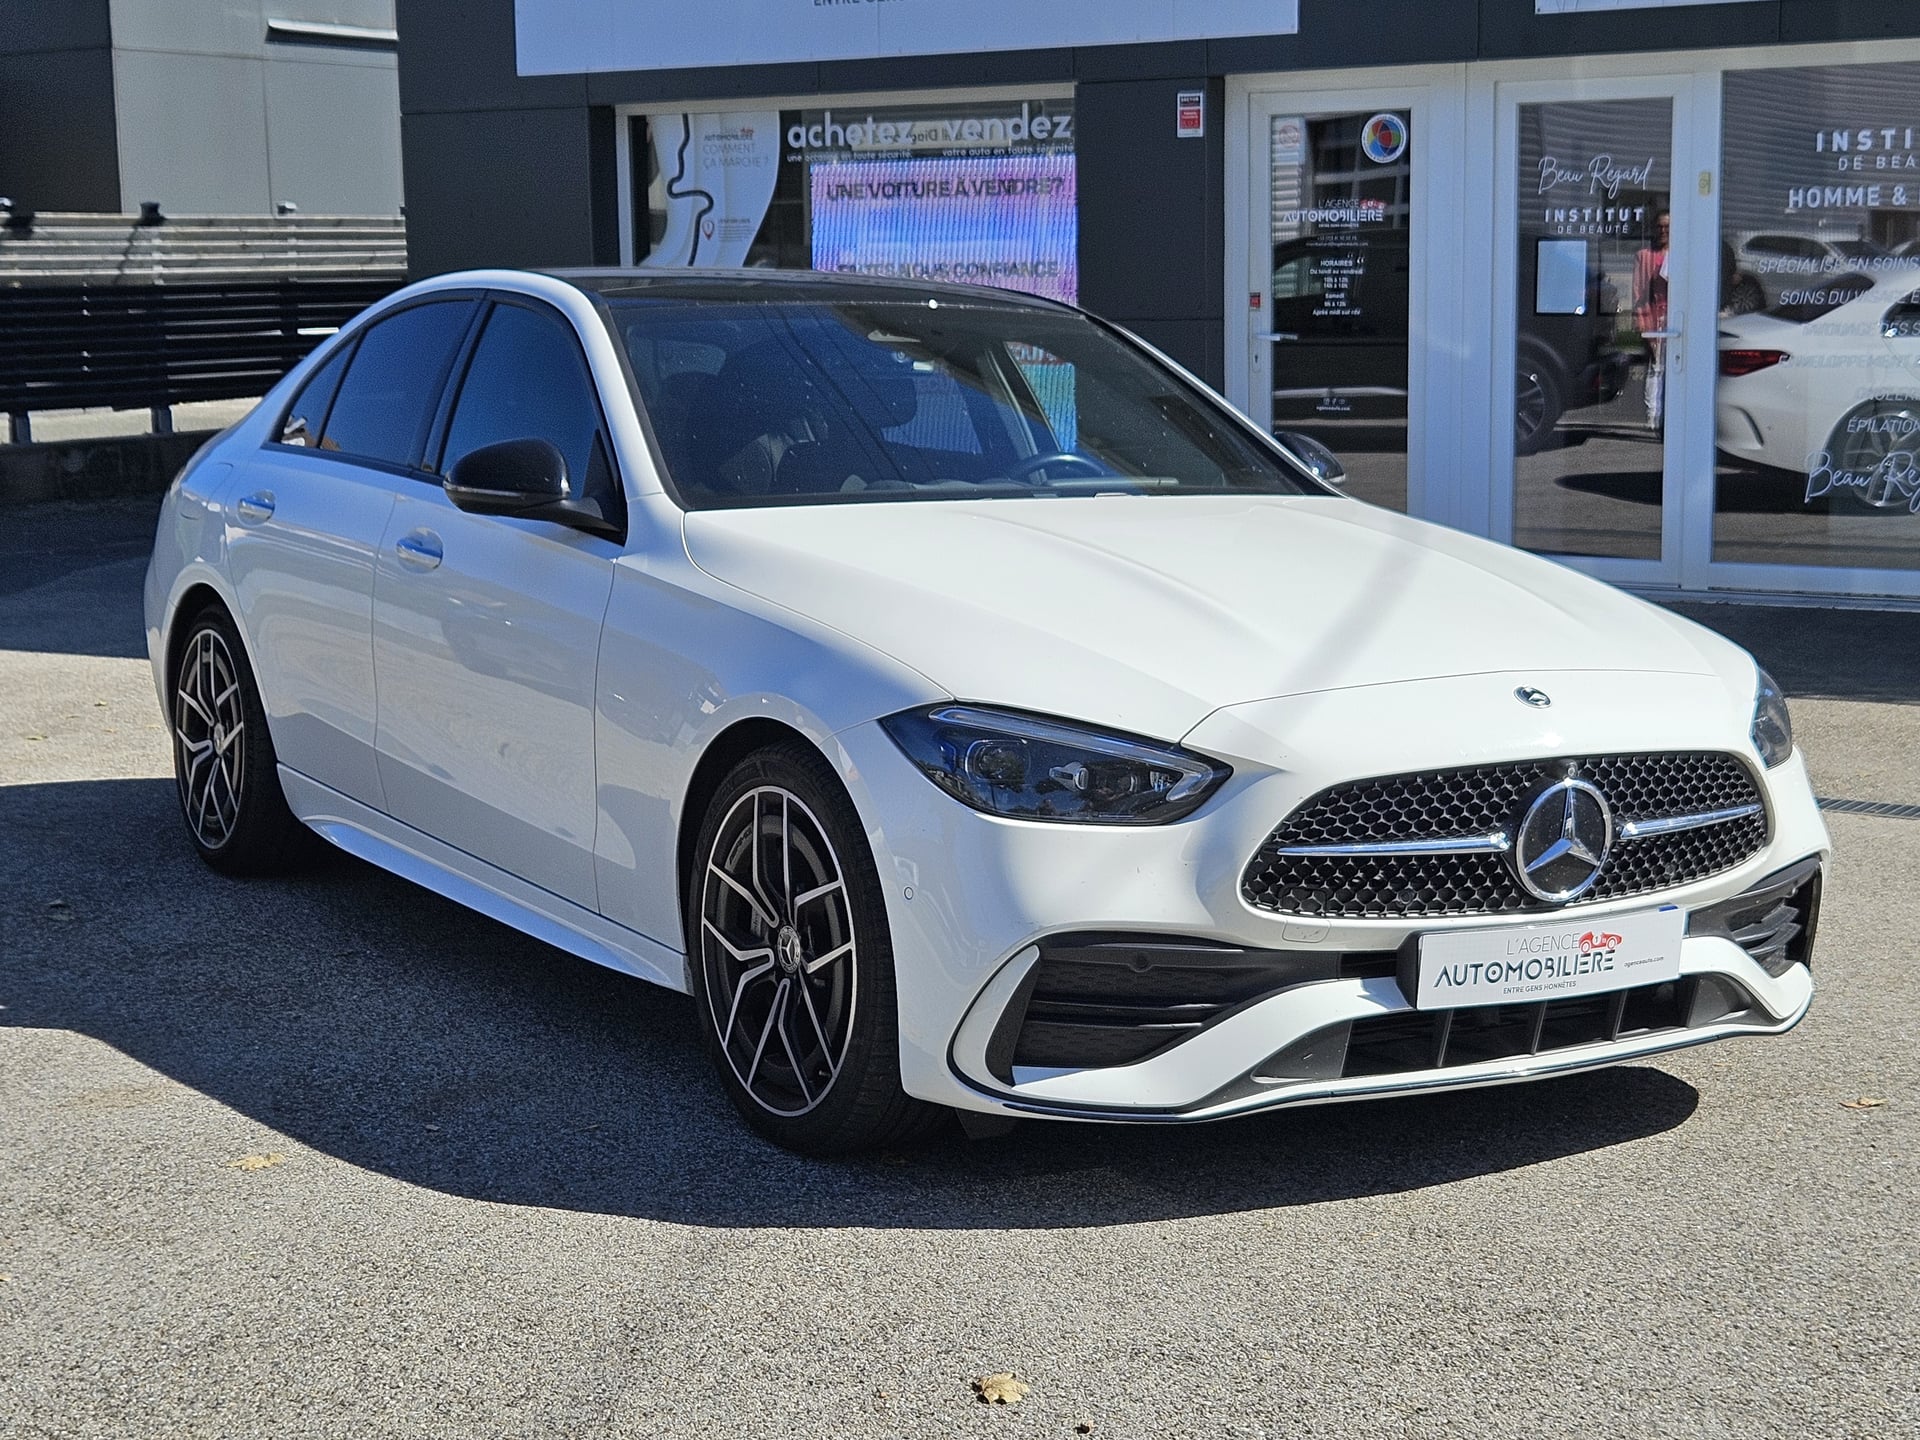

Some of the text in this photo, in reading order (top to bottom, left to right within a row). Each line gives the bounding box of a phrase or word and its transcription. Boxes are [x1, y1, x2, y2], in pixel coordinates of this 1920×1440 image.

[787, 102, 1072, 148] achetez vendez
[853, 151, 876, 160] toute
[942, 148, 967, 157] votre
[969, 147, 991, 156] auto
[993, 147, 1005, 155] en
[1008, 144, 1033, 154] toute
[1838, 154, 1916, 171] DE BEA
[1538, 156, 1583, 195] Beau
[1588, 153, 1653, 199] Regard
[826, 183, 866, 201] UNE
[868, 180, 951, 200] VOITURE
[1789, 185, 1907, 208] HOMME &
[1318, 199, 1360, 209] L'AGENCE
[1544, 208, 1644, 223] INSTITUT
[1557, 224, 1629, 235] DE BEAUTÉ
[953, 261, 1060, 278] CONFIANCE
[1848, 257, 1869, 272] EN
[1872, 255, 1920, 271] SOINS
[1779, 290, 1826, 305] SOINS
[1828, 289, 1851, 305] DU
[1312, 309, 1328, 317] Après
[1804, 450, 1871, 504] Beau
[1506, 932, 1582, 955] L'AGENCE
[1434, 949, 1616, 988] AUTOMOBILIERE
[1503, 980, 1577, 995] ENTRE GENS HONNÊTES
